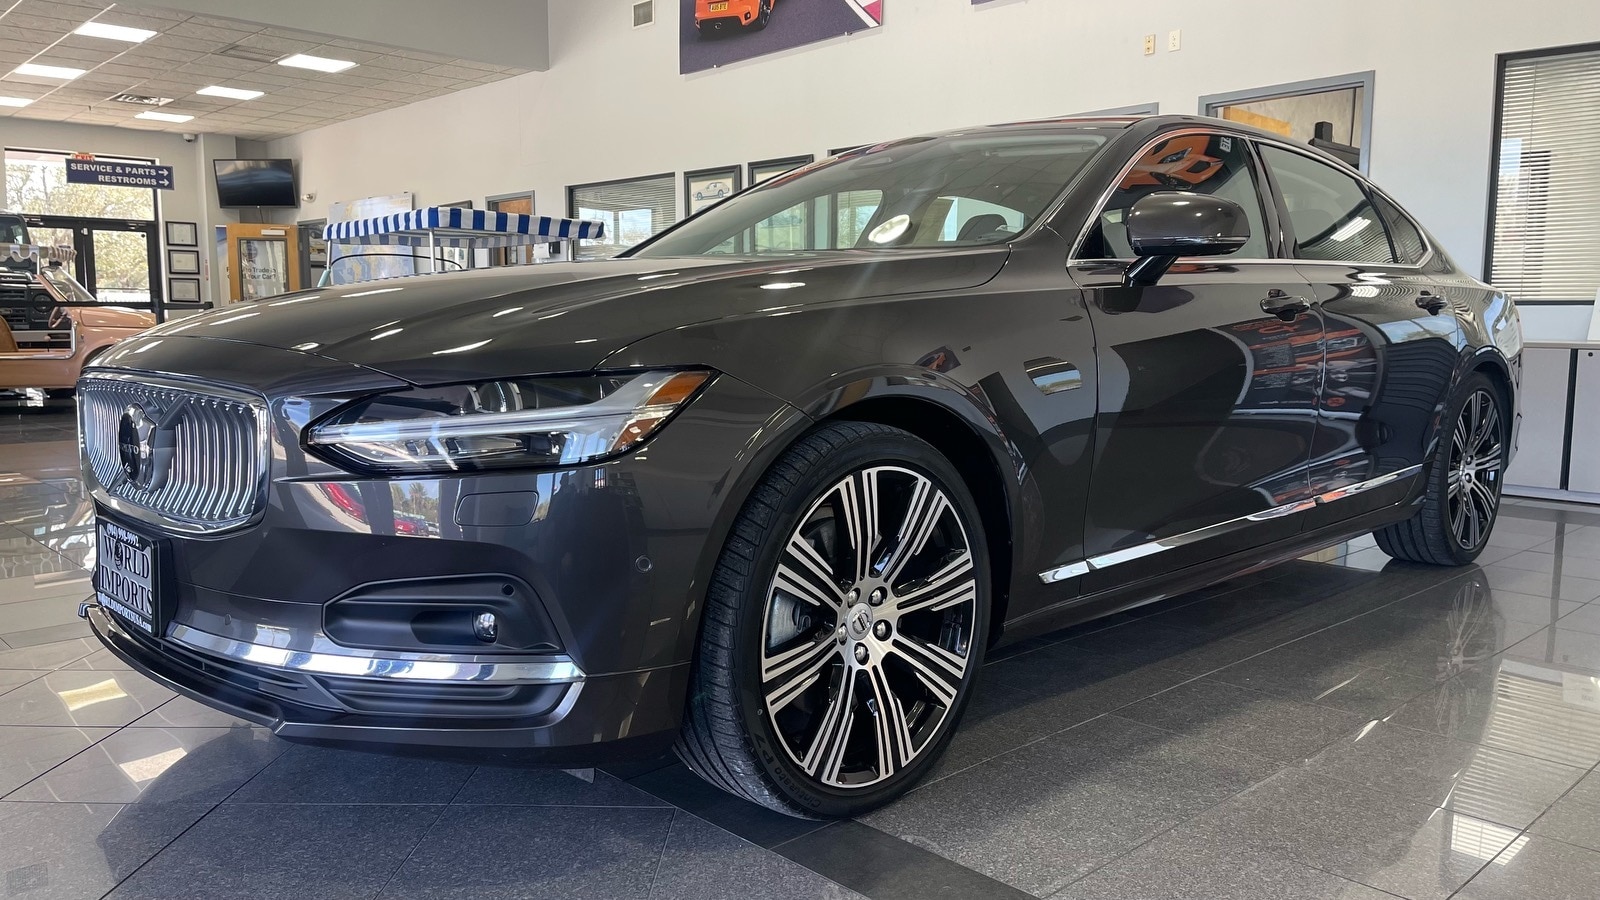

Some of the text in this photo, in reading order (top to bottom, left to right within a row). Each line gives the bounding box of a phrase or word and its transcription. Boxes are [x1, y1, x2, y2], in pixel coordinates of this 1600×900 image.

[70, 163, 113, 173] SERVICE
[125, 167, 156, 176] PARTS
[98, 175, 157, 186] RESTROOMS
[104, 534, 150, 579] WORLD
[98, 565, 152, 616] IMPORTS
[754, 733, 774, 765] P7
